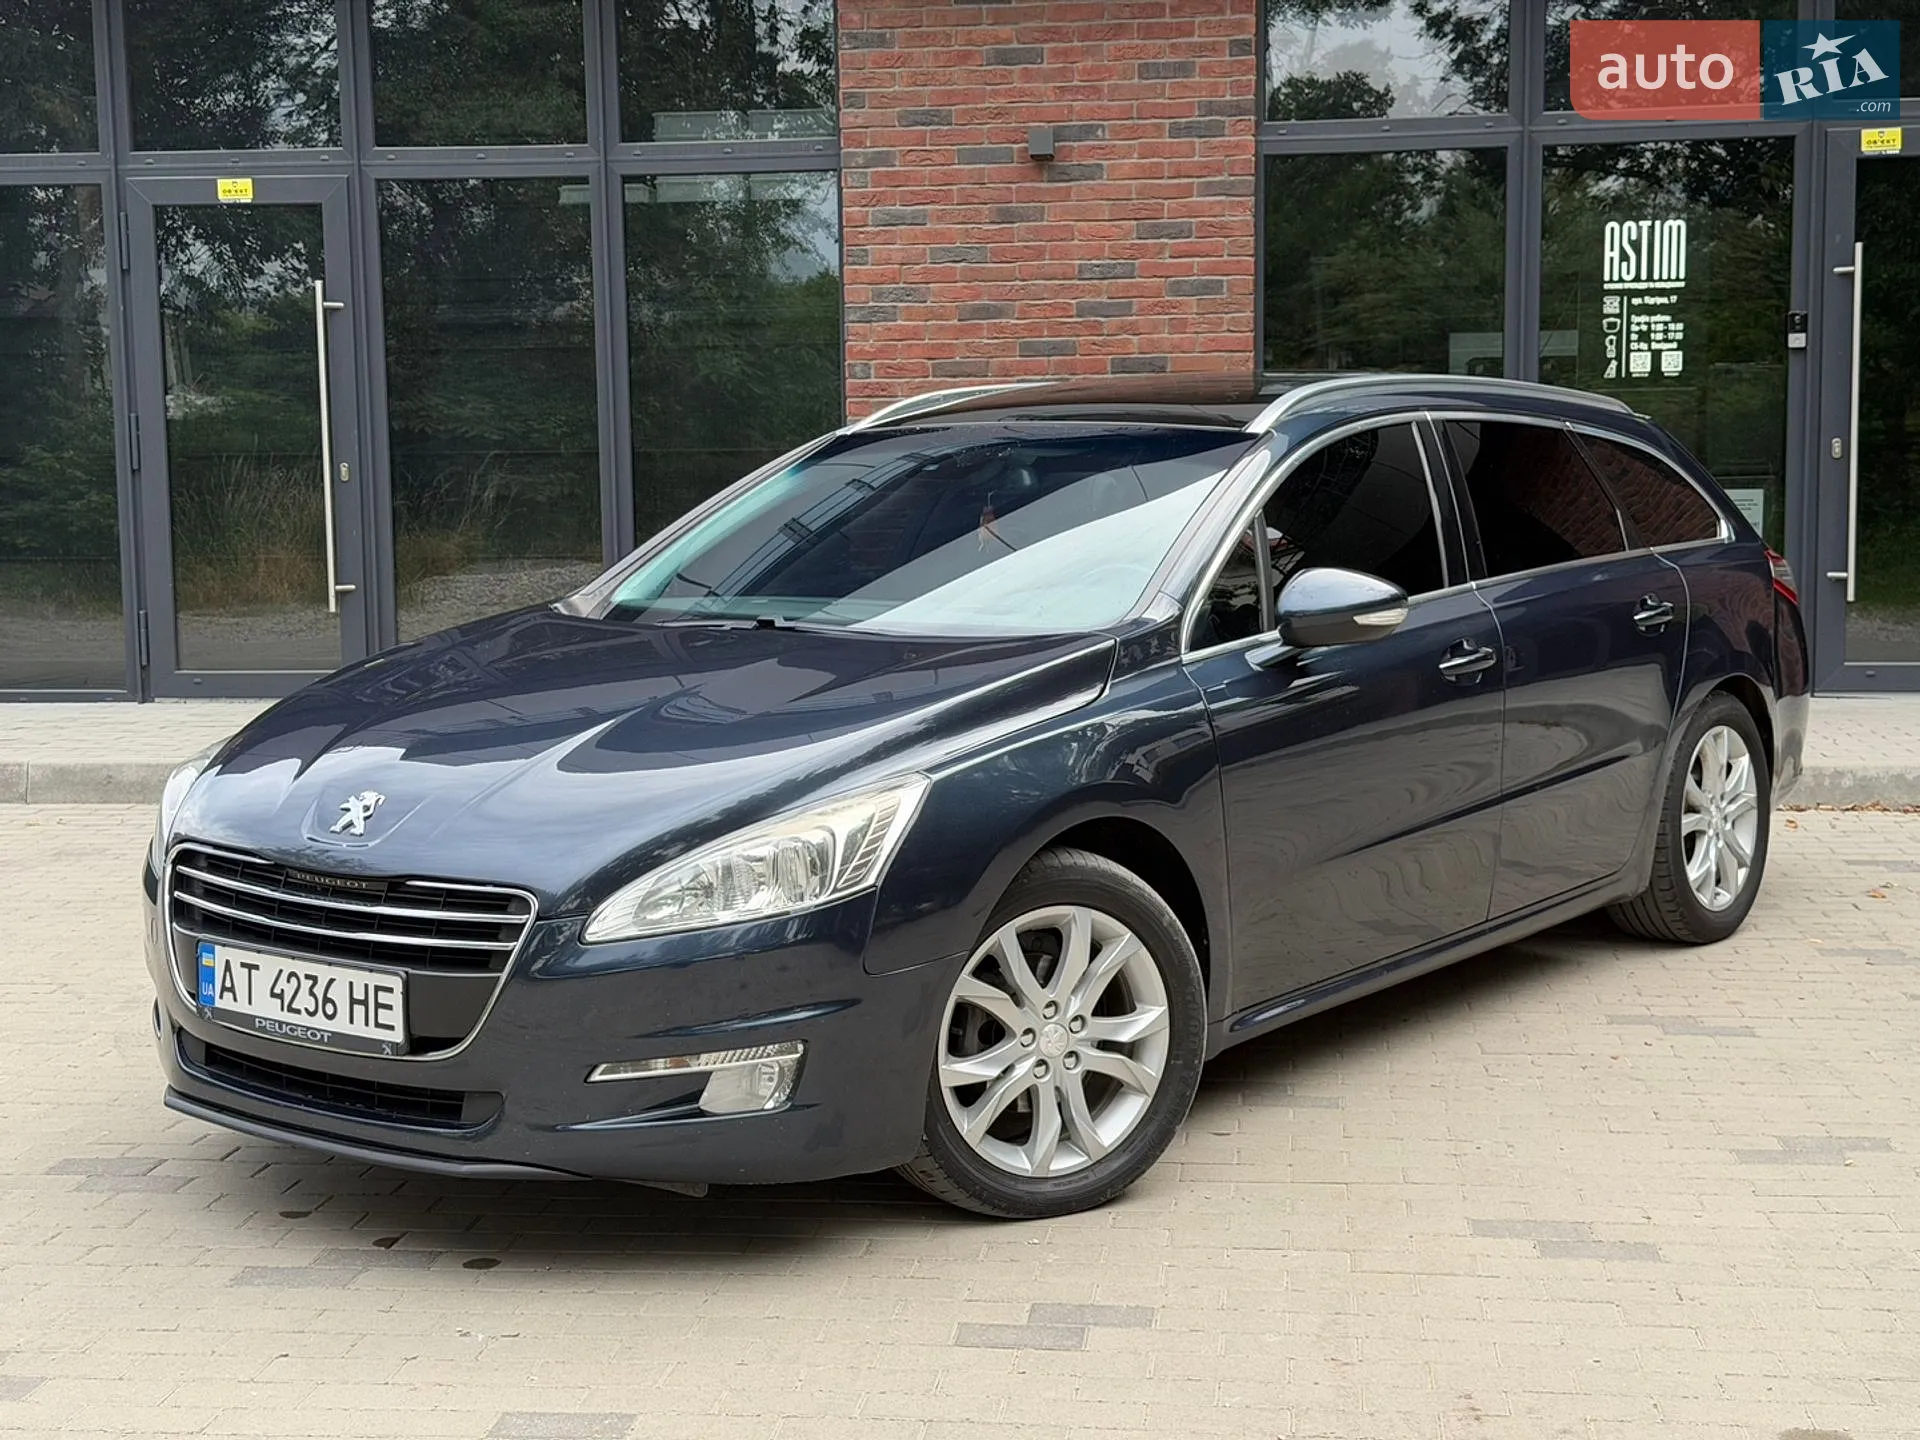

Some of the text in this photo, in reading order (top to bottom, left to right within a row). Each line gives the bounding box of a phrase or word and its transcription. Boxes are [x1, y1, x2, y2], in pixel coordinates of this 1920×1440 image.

[1603, 219, 1687, 281] ASTIM
[297, 873, 369, 889] PEUGEOT
[201, 981, 214, 996] UA
[219, 959, 396, 1031] AT 4236 HE
[255, 1017, 333, 1043] PEUGEOT
